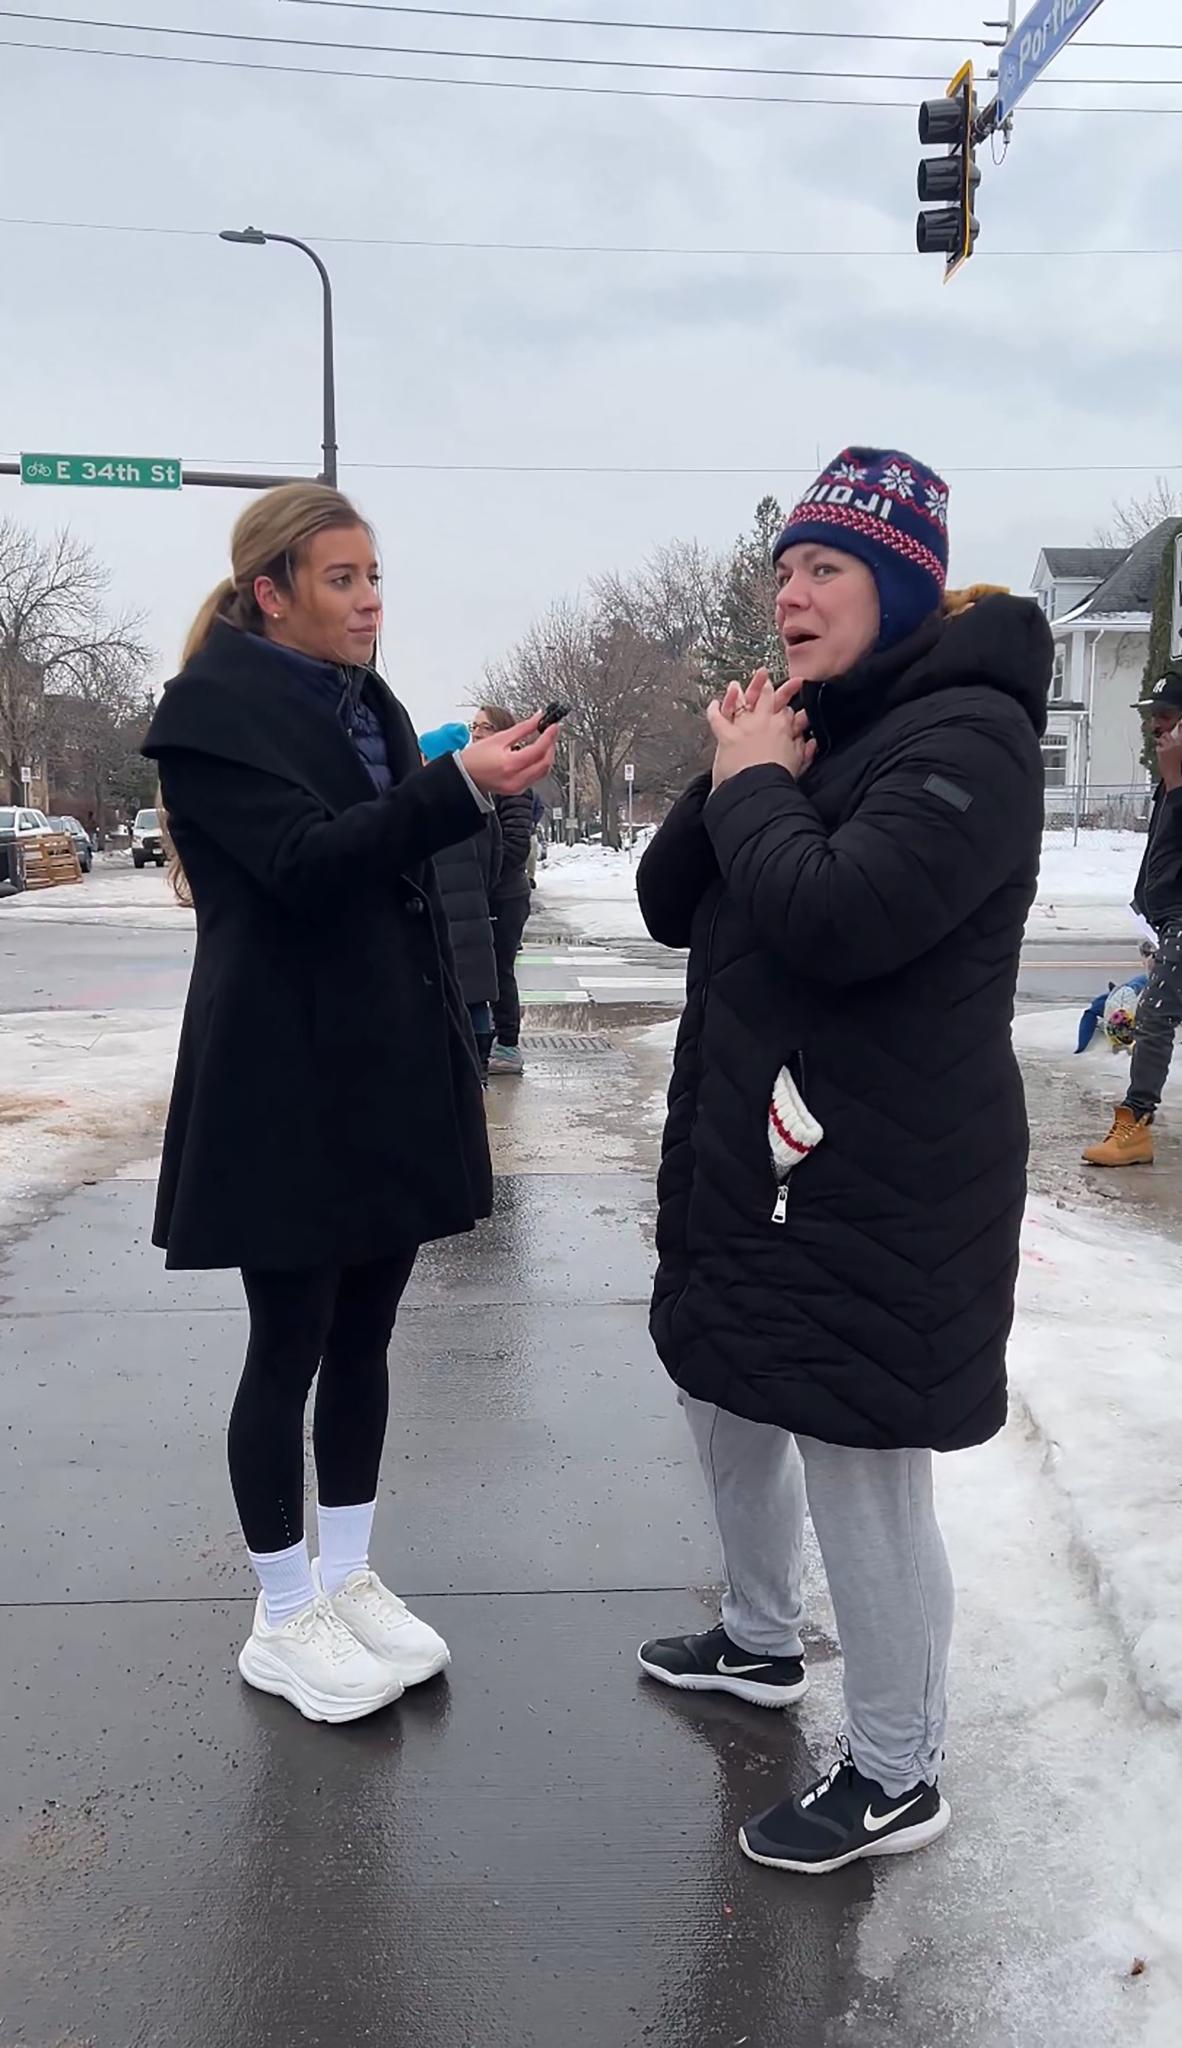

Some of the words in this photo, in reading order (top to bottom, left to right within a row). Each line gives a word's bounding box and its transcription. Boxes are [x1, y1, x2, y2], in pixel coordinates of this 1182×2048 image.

[1019, 0, 1083, 81] Portla
[57, 461, 71, 479] E
[81, 462, 140, 482] 34th
[151, 465, 175, 483] St
